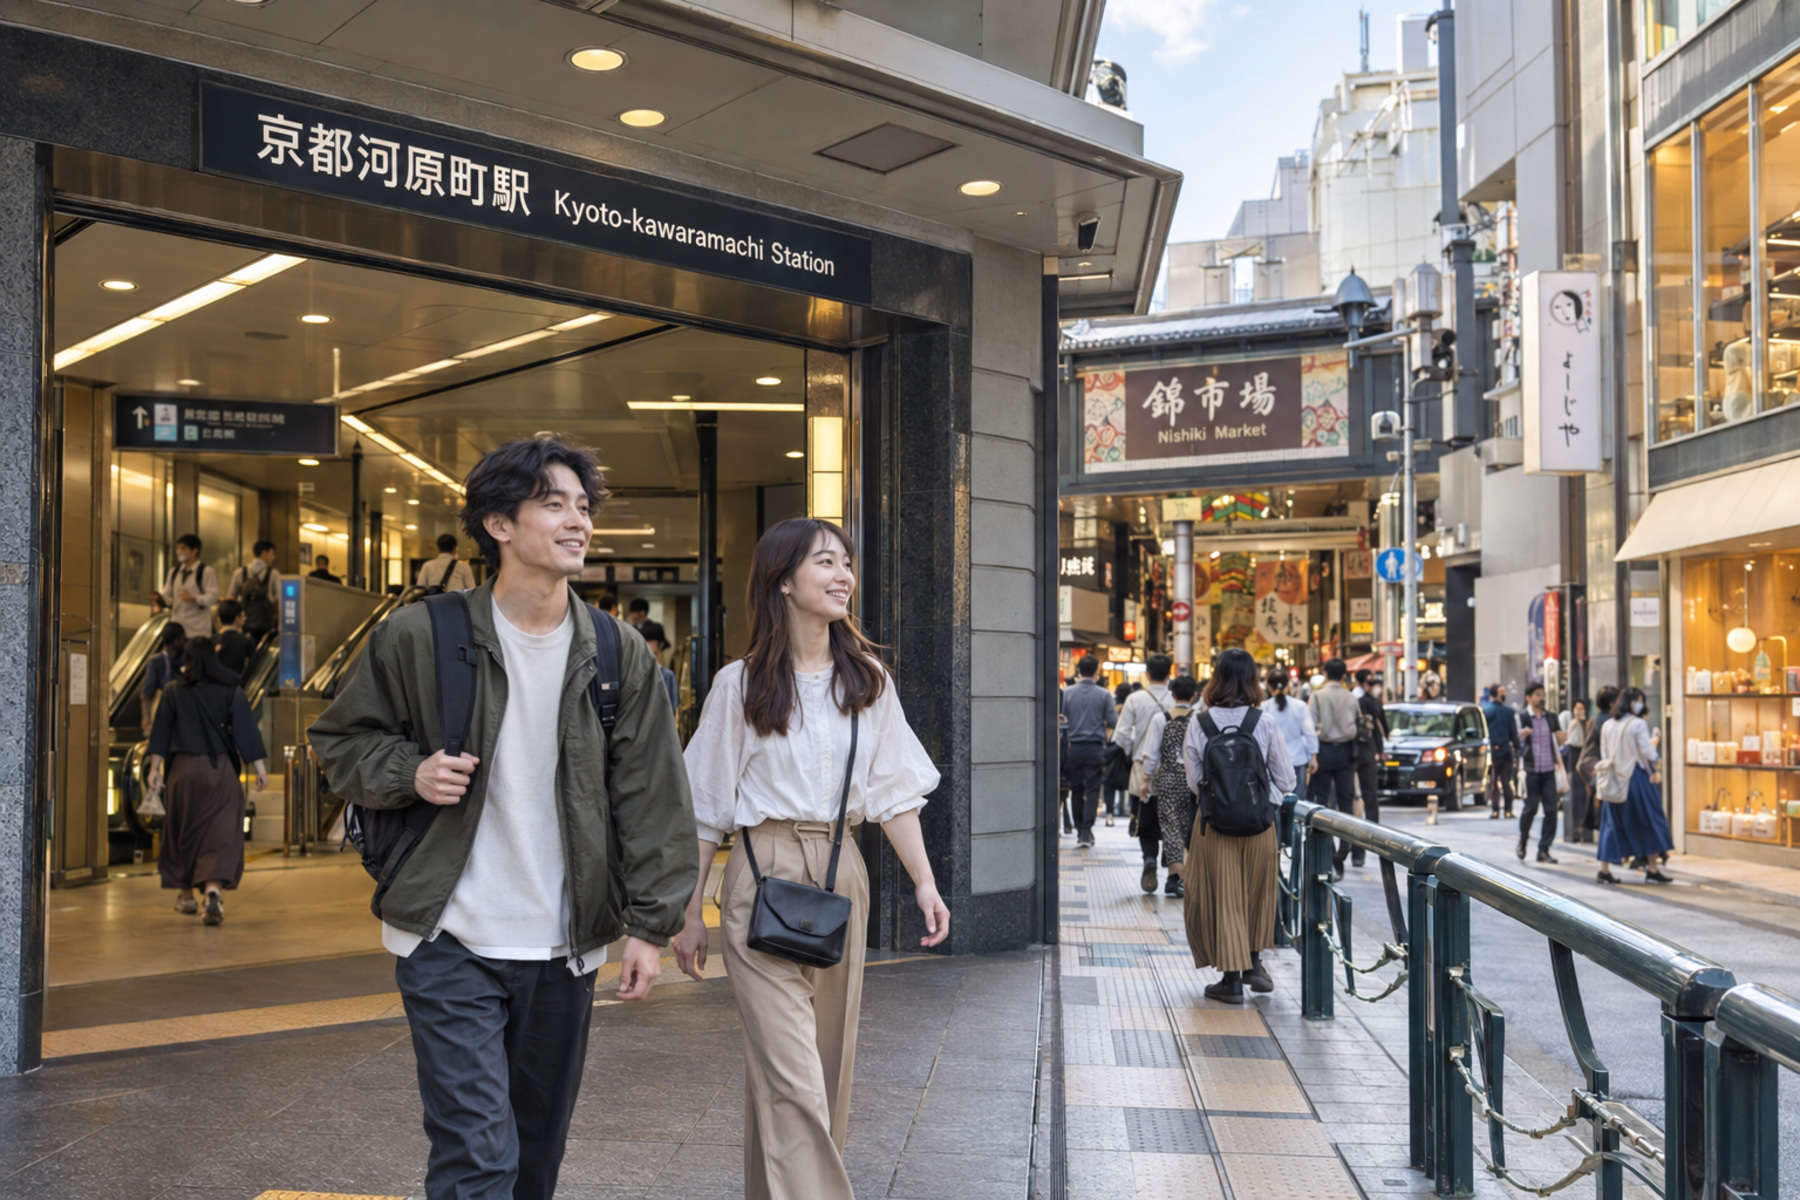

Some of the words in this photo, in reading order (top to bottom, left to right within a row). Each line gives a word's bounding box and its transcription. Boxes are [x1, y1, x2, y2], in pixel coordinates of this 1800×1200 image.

[257, 112, 531, 217] 京都河原町駅
[554, 189, 764, 262] Kyoto-kawaramachi
[771, 241, 835, 278] Station
[1141, 371, 1277, 427] 錦市場
[1157, 427, 1207, 444] Nishiki
[1214, 422, 1267, 440] Market
[1557, 351, 1580, 448] よーじや
